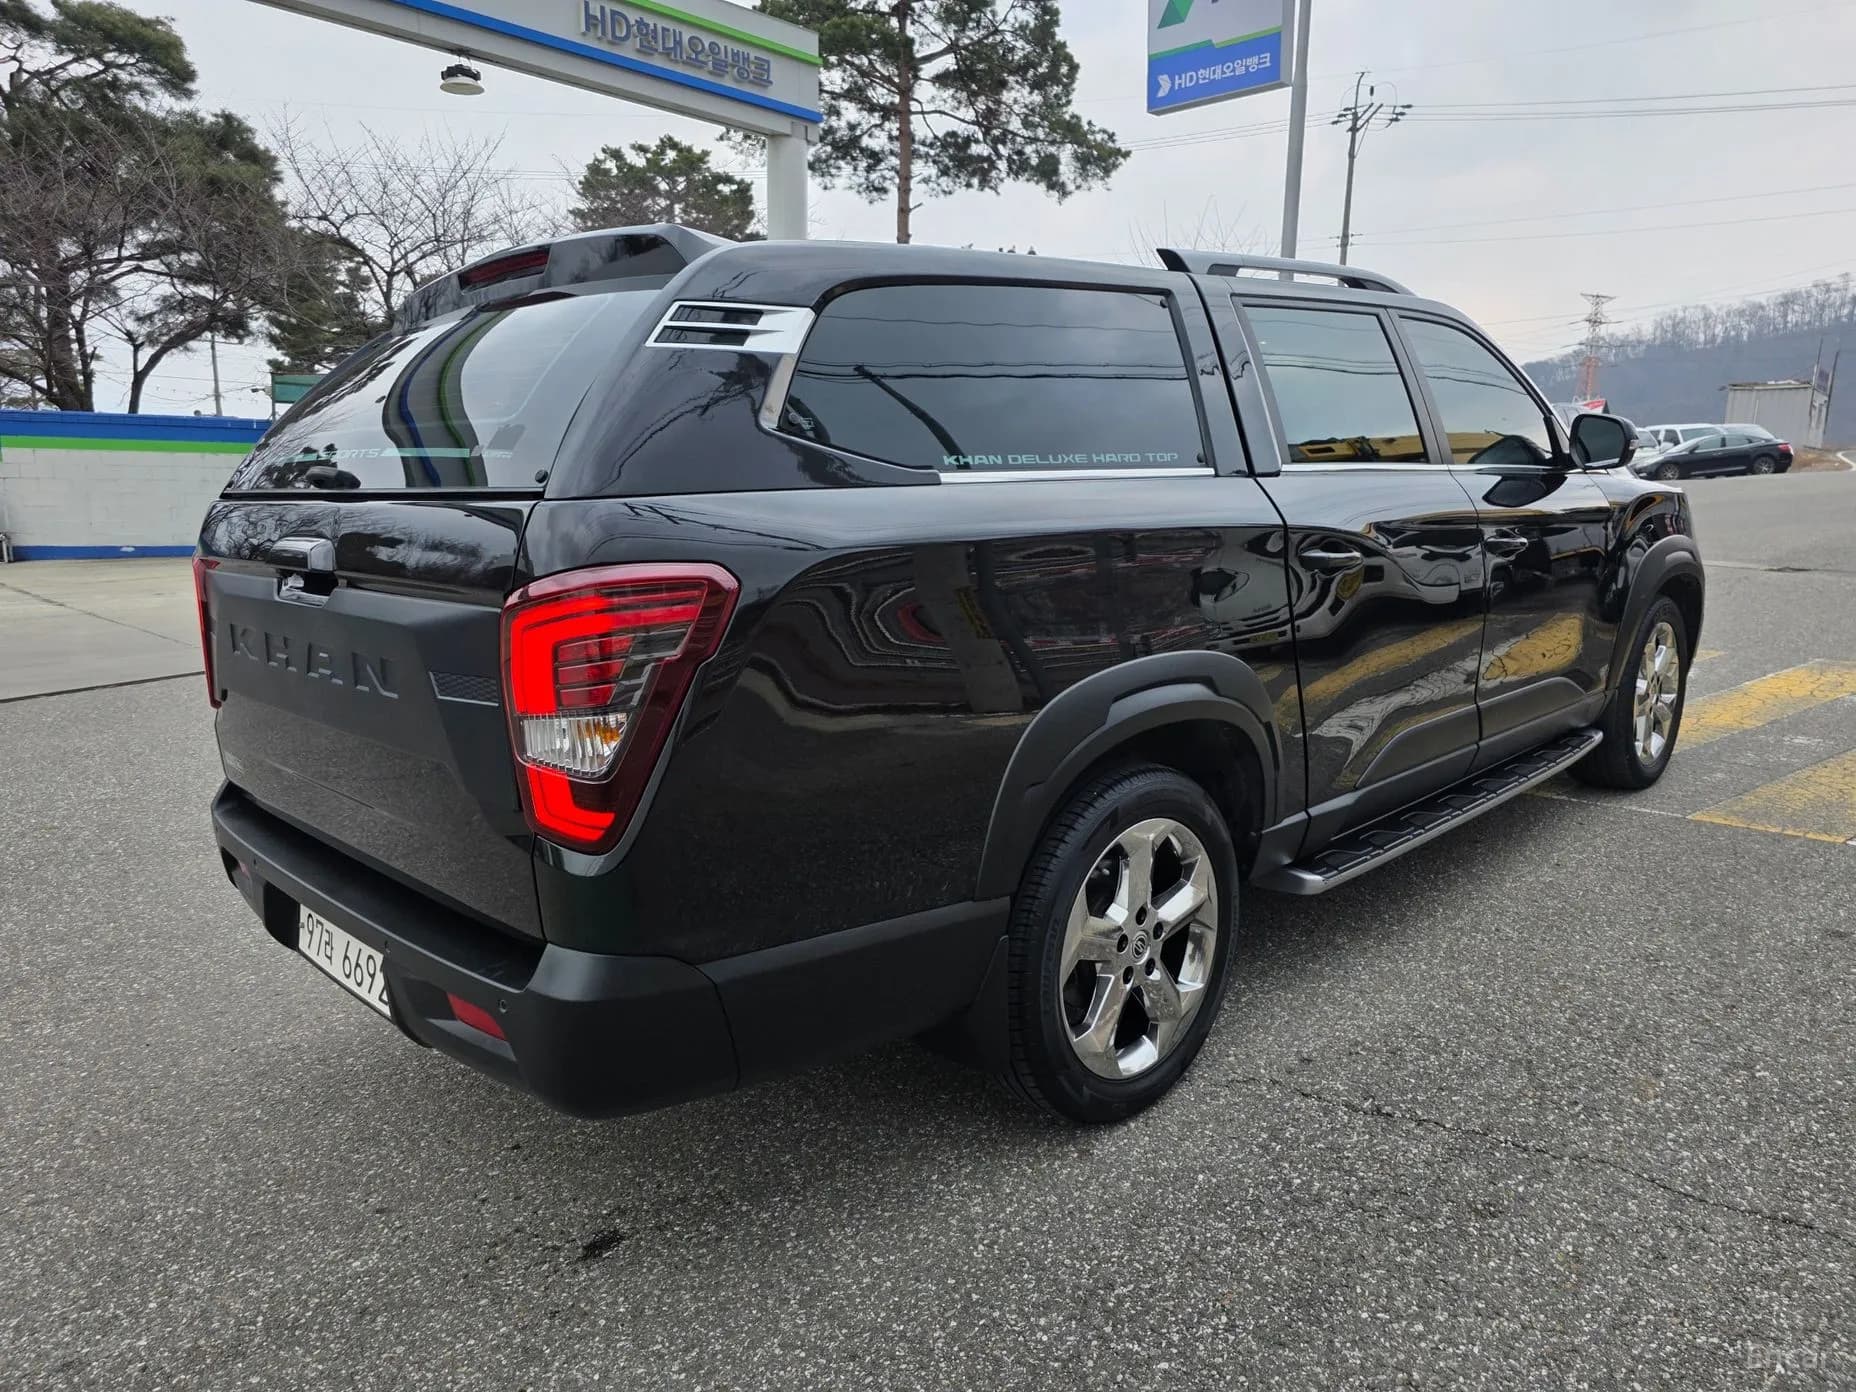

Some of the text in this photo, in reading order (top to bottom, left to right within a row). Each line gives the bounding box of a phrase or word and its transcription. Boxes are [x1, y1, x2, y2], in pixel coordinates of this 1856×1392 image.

[583, 0, 773, 86] HD현대오일뱅크
[1175, 53, 1271, 90] HD현대오일뱅크
[943, 452, 1179, 466] KHAN DELUXE HARD TOP
[230, 623, 399, 699] KHAN
[307, 912, 334, 966] 97라
